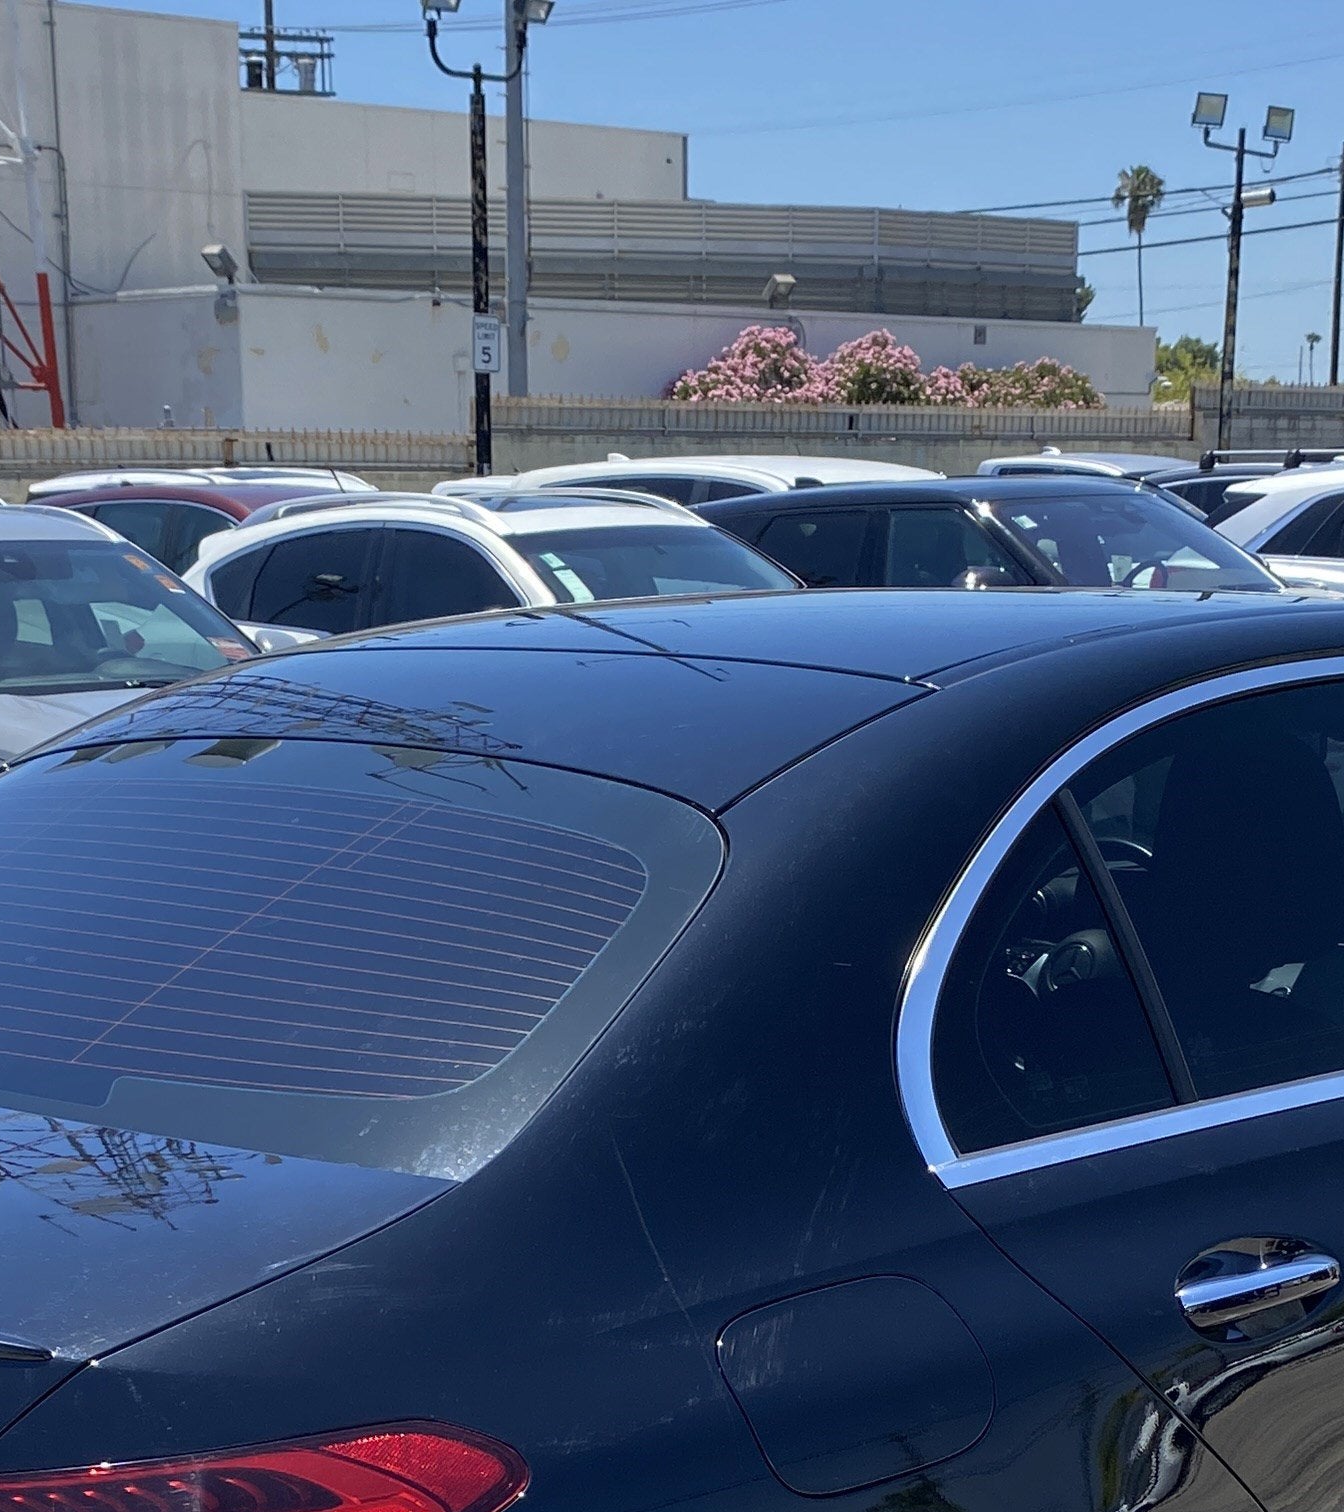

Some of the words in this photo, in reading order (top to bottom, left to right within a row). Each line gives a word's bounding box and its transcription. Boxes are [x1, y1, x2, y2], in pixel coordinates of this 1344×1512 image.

[475, 322, 498, 330] SPEED
[477, 332, 495, 340] LIMIT
[481, 346, 492, 364] 5
